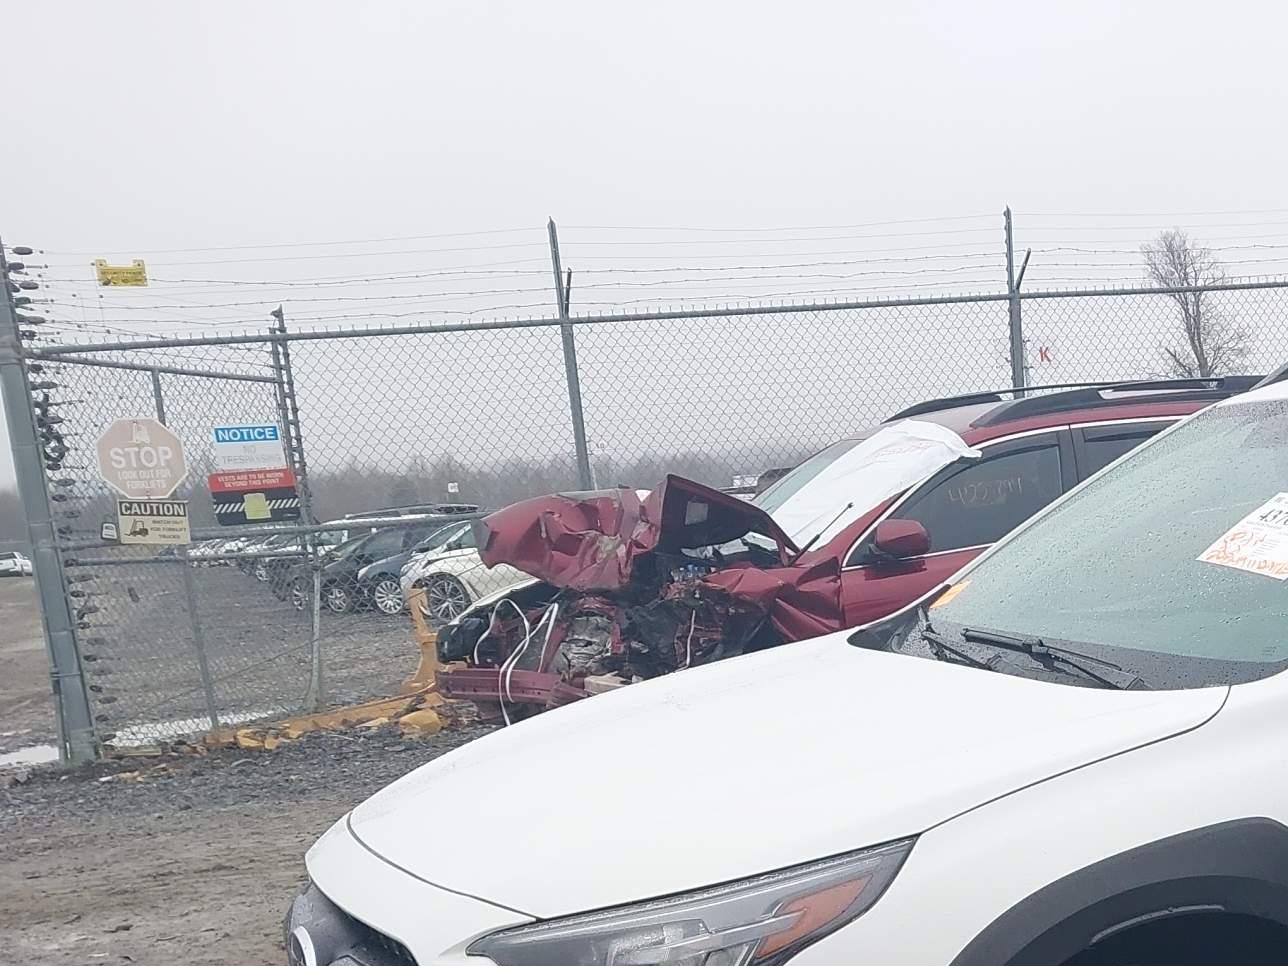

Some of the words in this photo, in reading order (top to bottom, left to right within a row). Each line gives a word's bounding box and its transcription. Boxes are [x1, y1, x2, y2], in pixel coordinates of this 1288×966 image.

[217, 427, 276, 441] NOTICE
[109, 446, 172, 469] STOP
[139, 469, 154, 479] OUT
[121, 503, 185, 516] CAUTION
